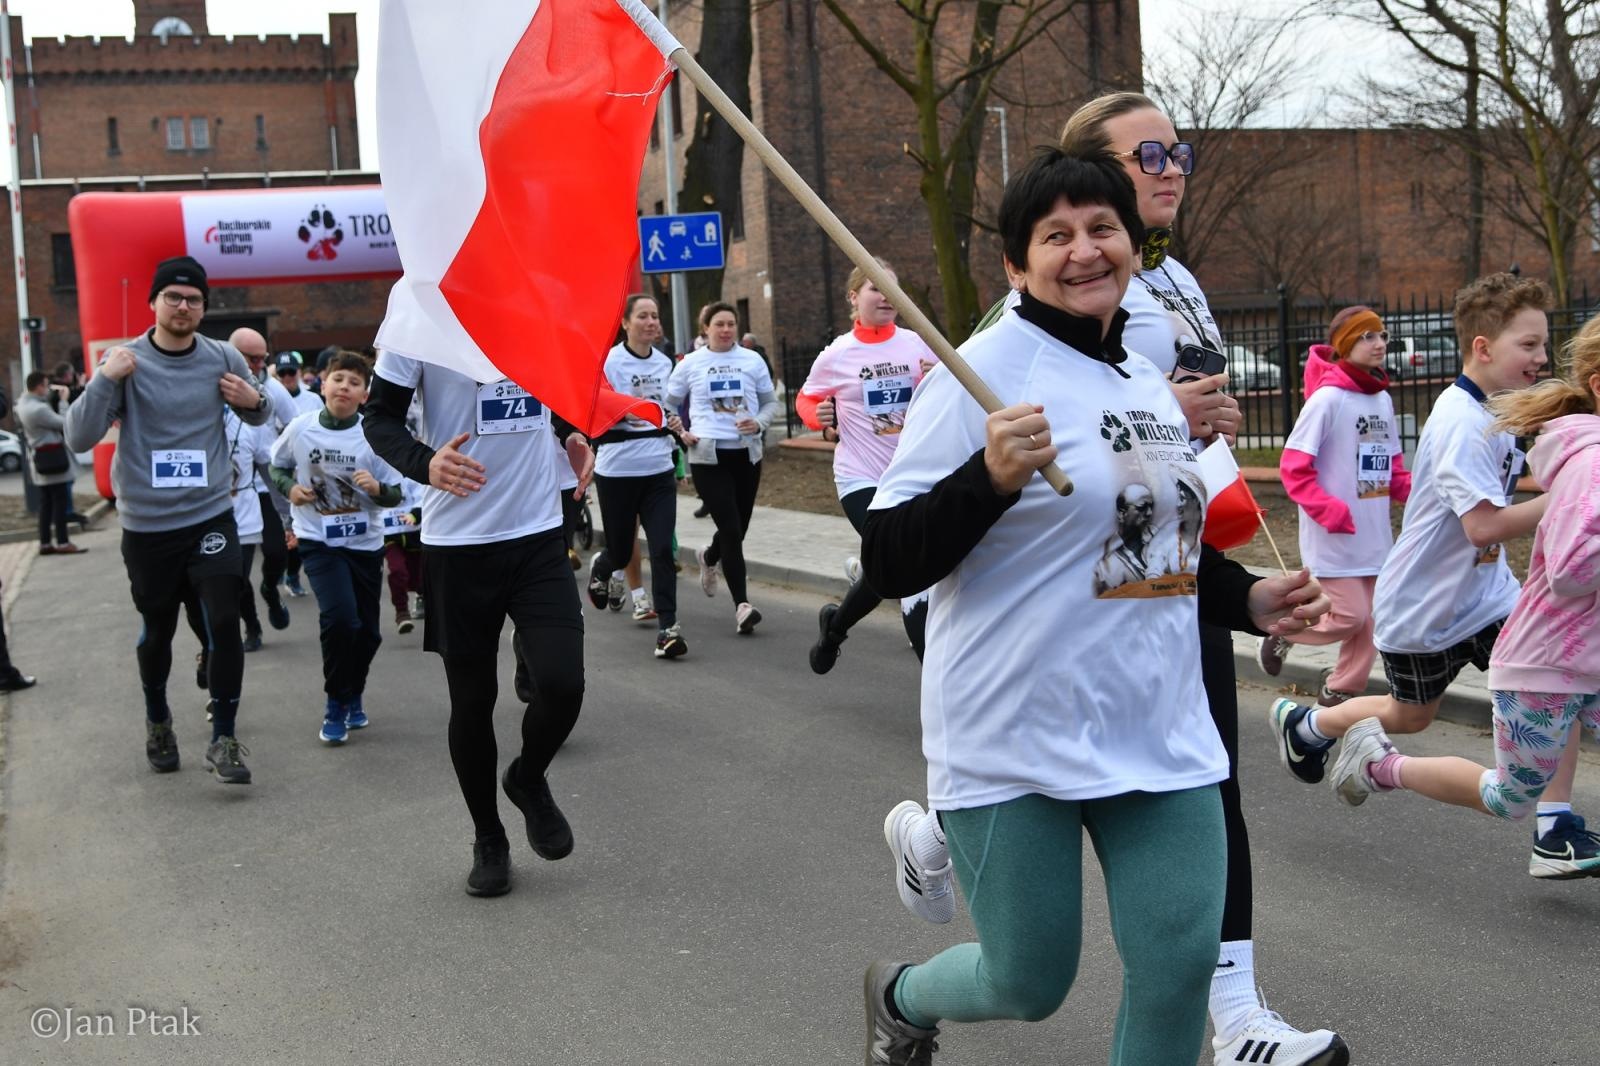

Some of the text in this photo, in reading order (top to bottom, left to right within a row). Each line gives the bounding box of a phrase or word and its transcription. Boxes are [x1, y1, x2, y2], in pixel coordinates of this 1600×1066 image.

[348, 214, 391, 236] TRO
[876, 364, 910, 377] WILCZYM
[722, 381, 730, 390] 4
[882, 389, 901, 404] 37
[501, 398, 527, 418] 74
[1125, 410, 1158, 422] TROPEM
[170, 462, 191, 477] 76
[1371, 456, 1387, 470] 107
[340, 524, 356, 536] 12
